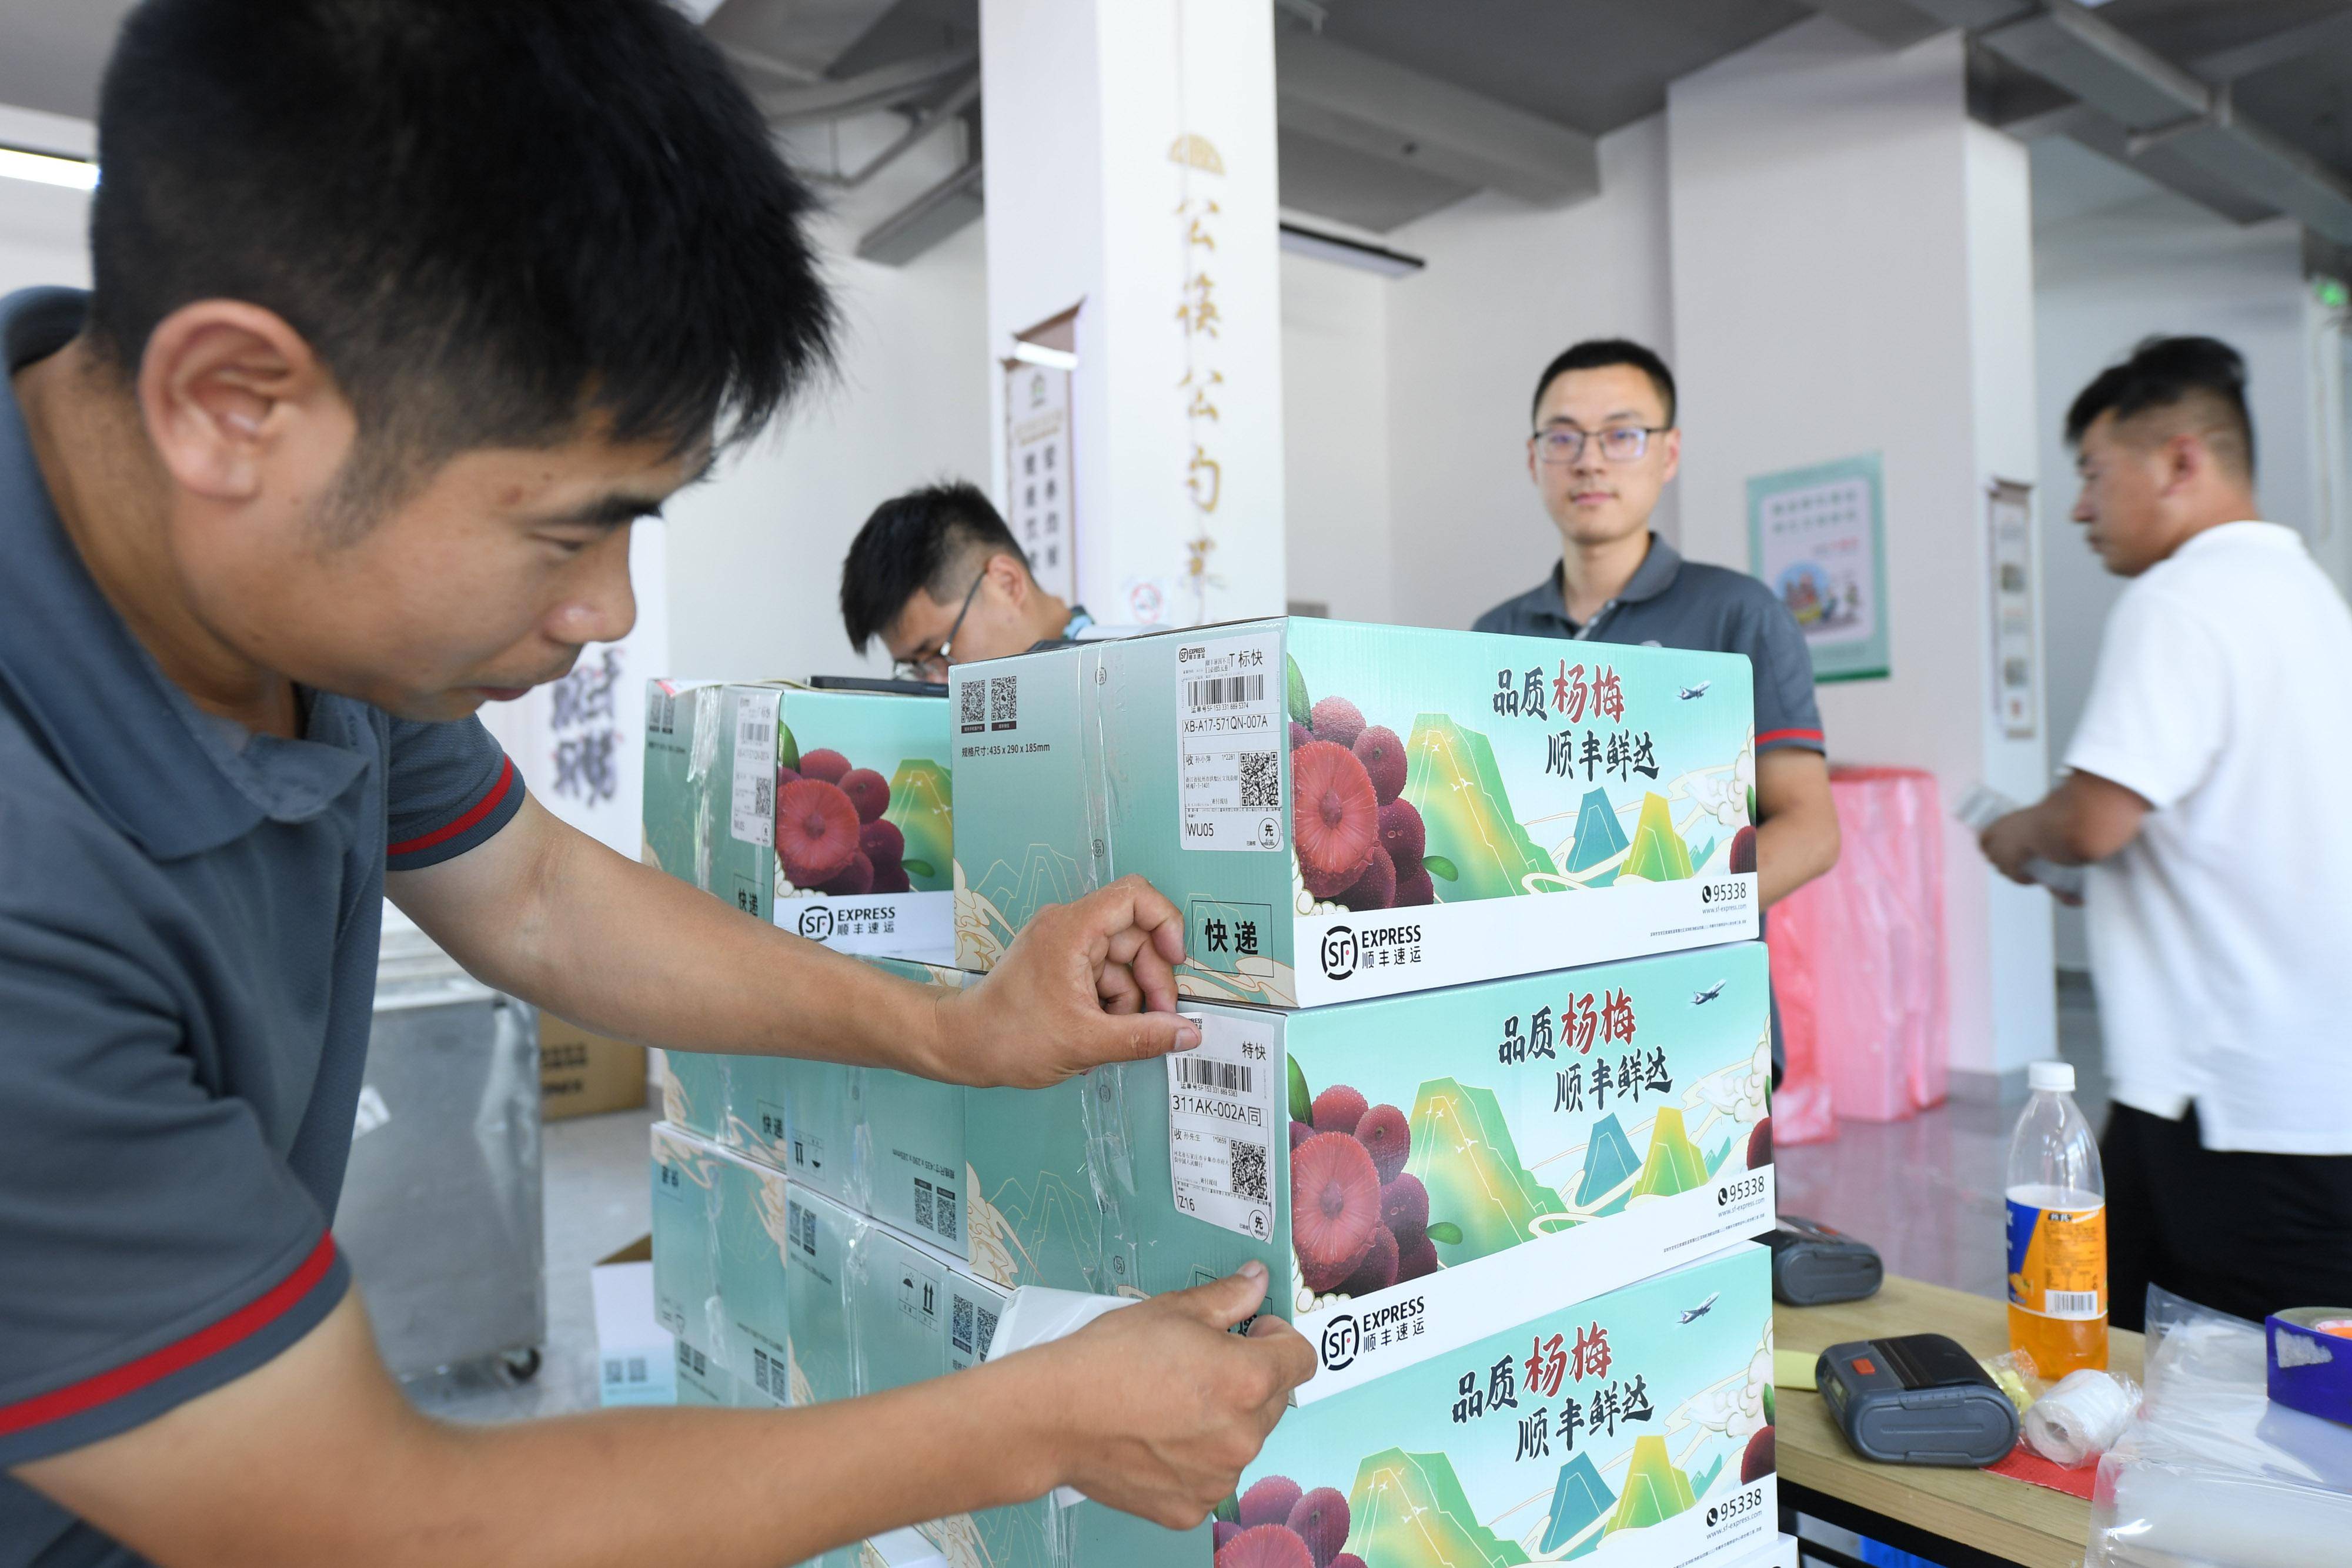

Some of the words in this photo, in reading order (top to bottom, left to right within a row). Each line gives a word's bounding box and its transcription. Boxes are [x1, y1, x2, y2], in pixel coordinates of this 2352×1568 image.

[1492, 658, 1625, 724] 品质杨梅
[1184, 715, 1268, 733] XB-A17-571QN-007A
[1007, 744, 1018, 754] 290
[1025, 743, 1050, 753] 185mm
[1545, 729, 1660, 783] 顺丰鲜达
[1187, 823, 1214, 837] WU05
[1265, 824, 1274, 837] 先
[1713, 882, 1746, 901] 95338
[838, 907, 895, 921] EXPRESS
[1702, 903, 1747, 914] www.sf-express.com
[837, 922, 894, 936] 顺丰速运
[1204, 918, 1258, 955] 快递
[1362, 925, 1421, 948] EXPRESS
[1362, 945, 1421, 969] 顺丰速运
[1498, 987, 1636, 1065] 品质杨梅
[1242, 1041, 1267, 1061] 特快
[1553, 1046, 1673, 1113] 顺丰鲜达
[1730, 1176, 1765, 1202] 95338
[1178, 1195, 1195, 1211] Z16
[1718, 1197, 1765, 1218] www.sf-express.com
[1255, 1216, 1263, 1230] 先
[1364, 1296, 1425, 1333] EXPRESS
[1363, 1317, 1425, 1354] 顺丰速运
[1452, 1321, 1612, 1424] 品质杨梅
[1515, 1373, 1655, 1462] 顺丰鲜达
[1720, 1487, 1762, 1522] 95338
[1706, 1509, 1763, 1540] www.sf-express.com
